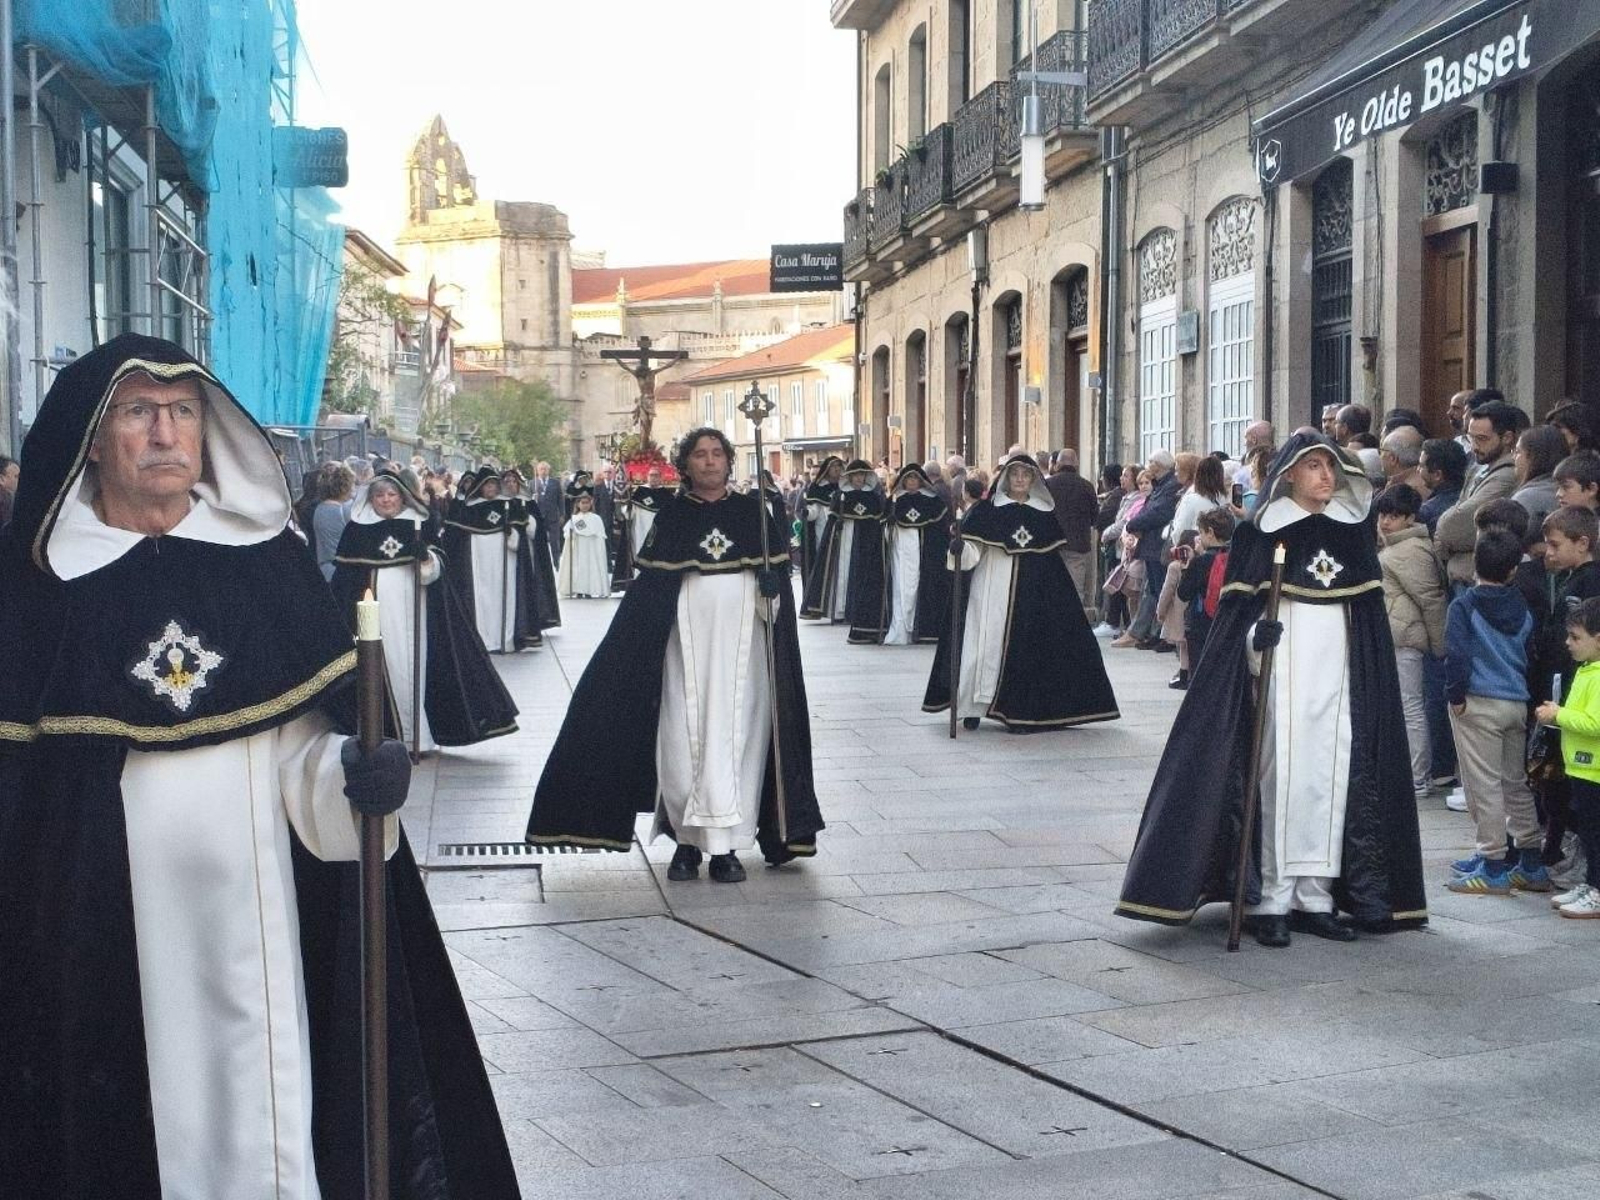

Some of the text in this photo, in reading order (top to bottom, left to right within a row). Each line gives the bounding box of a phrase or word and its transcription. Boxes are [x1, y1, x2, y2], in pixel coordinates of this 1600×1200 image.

[1333, 14, 1532, 151] Ye Olde Basset
[775, 253, 837, 270] Casa Maruja
